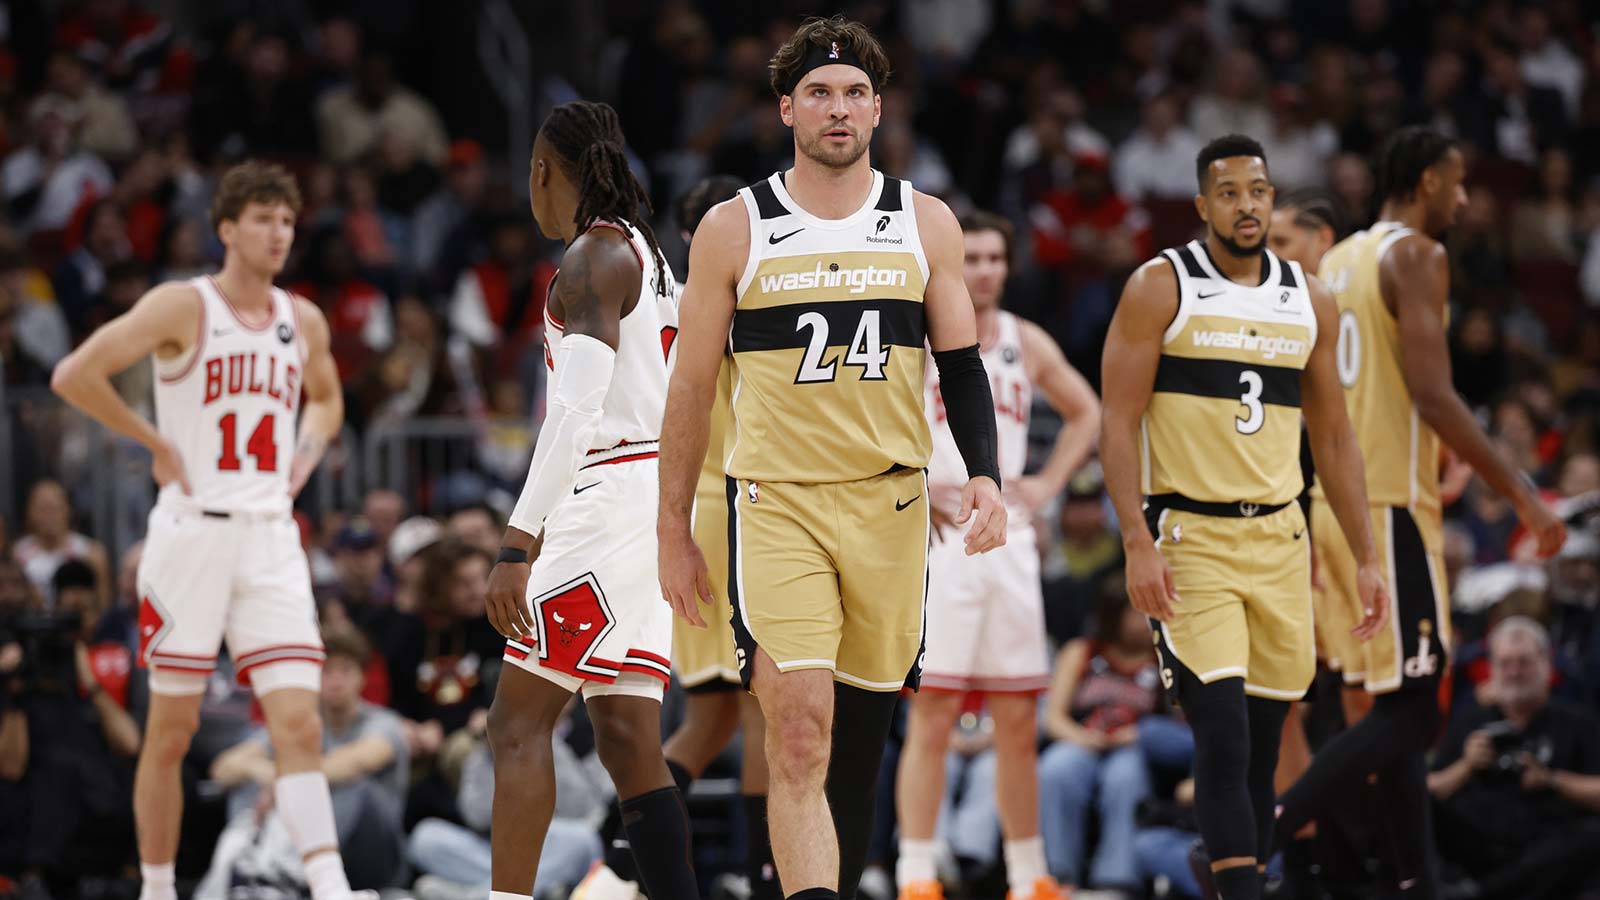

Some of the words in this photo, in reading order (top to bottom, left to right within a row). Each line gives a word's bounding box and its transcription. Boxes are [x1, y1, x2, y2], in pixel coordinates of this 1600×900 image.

[866, 236, 903, 245] Robinhood
[760, 260, 907, 294] washington
[794, 309, 892, 385] 24
[1193, 325, 1307, 359] washington
[203, 353, 298, 411] BULLS
[1235, 369, 1265, 435] 3
[217, 412, 277, 472] 14
